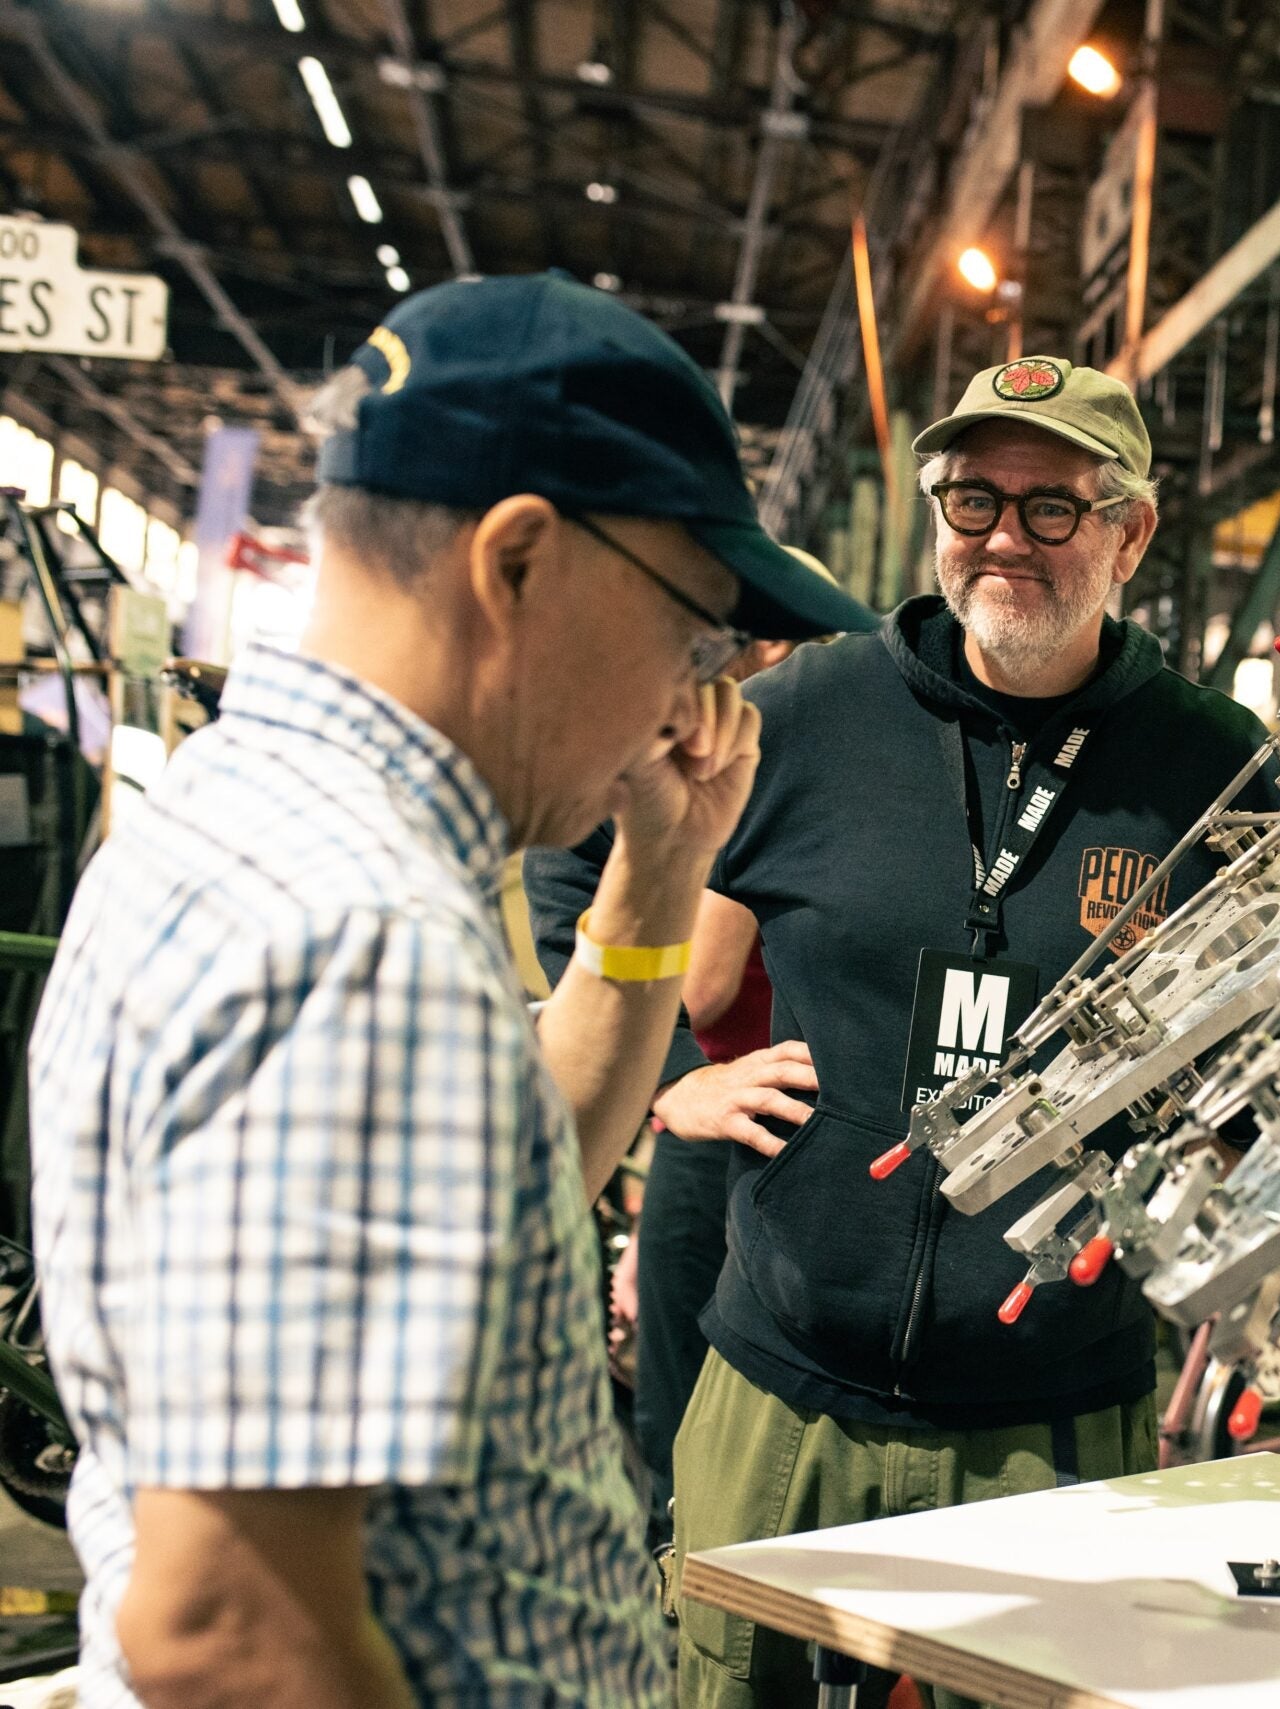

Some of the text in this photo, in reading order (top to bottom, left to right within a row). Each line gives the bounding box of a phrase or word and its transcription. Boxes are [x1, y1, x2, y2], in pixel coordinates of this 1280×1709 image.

[85, 285, 142, 346] ST
[1053, 727, 1090, 768] MADE
[1017, 785, 1055, 832] MADE
[983, 848, 1020, 897] MADE
[937, 968, 1010, 1054] M
